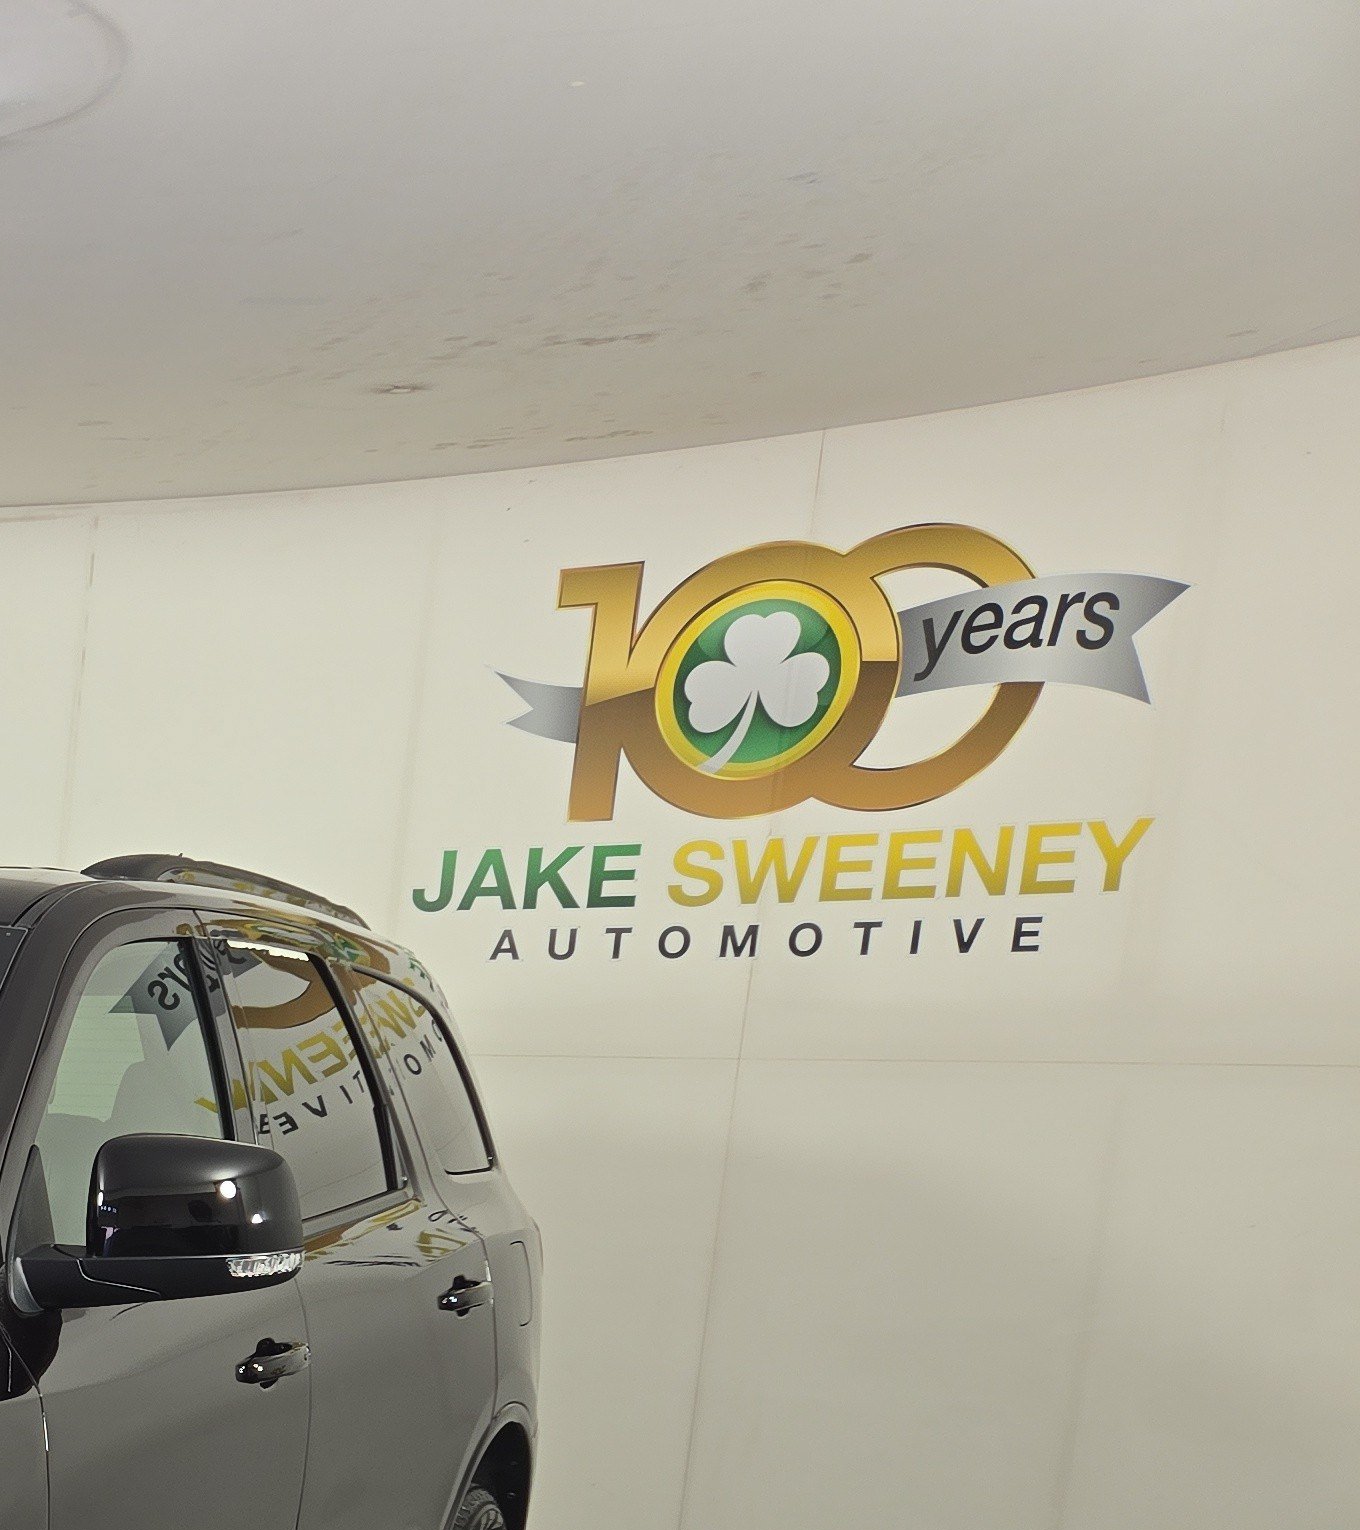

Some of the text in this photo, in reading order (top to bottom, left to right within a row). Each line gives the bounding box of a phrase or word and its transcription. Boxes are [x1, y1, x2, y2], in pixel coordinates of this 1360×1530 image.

[558, 523, 1045, 823] 100
[914, 588, 1120, 683] years
[412, 817, 1155, 914] JAKE SWEENEY
[489, 915, 1045, 961] AUTOMOTIVE
